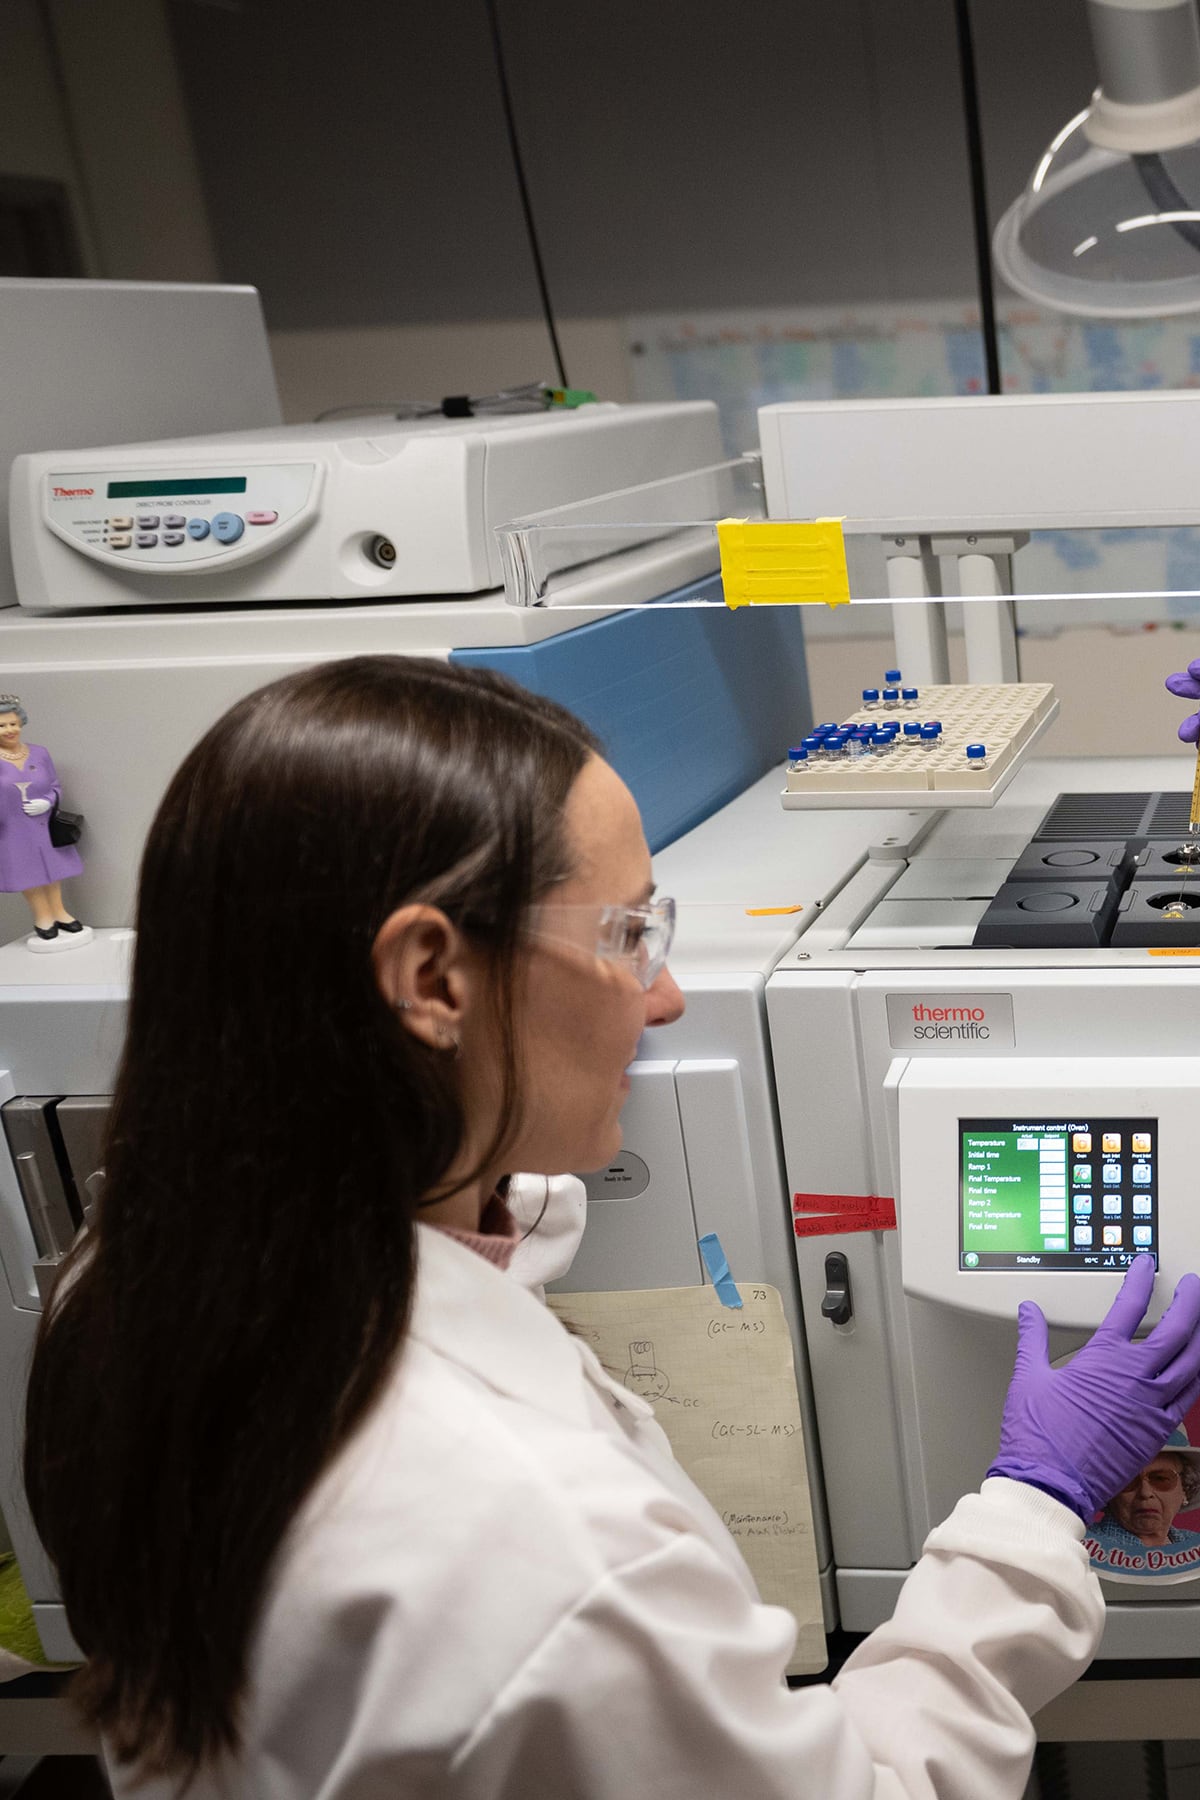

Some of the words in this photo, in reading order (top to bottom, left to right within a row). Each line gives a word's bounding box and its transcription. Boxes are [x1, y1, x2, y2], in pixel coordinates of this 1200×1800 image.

[53, 487, 95, 496] Thermo
[912, 1003, 985, 1021] thermo
[914, 1022, 990, 1039] scientific
[1012, 1124, 1045, 1132] Instrument
[1046, 1124, 1067, 1132] control
[1068, 1123, 1089, 1132] (Oven)
[967, 1139, 1006, 1147] Temperature
[968, 1163, 985, 1171] Ramp
[983, 1175, 1021, 1183] Temperature
[968, 1199, 985, 1207] Ramp
[984, 1211, 1022, 1219] Temperature
[1016, 1255, 1041, 1264] Standby
[753, 1290, 767, 1300] 73
[1110, 1548, 1145, 1570] the
